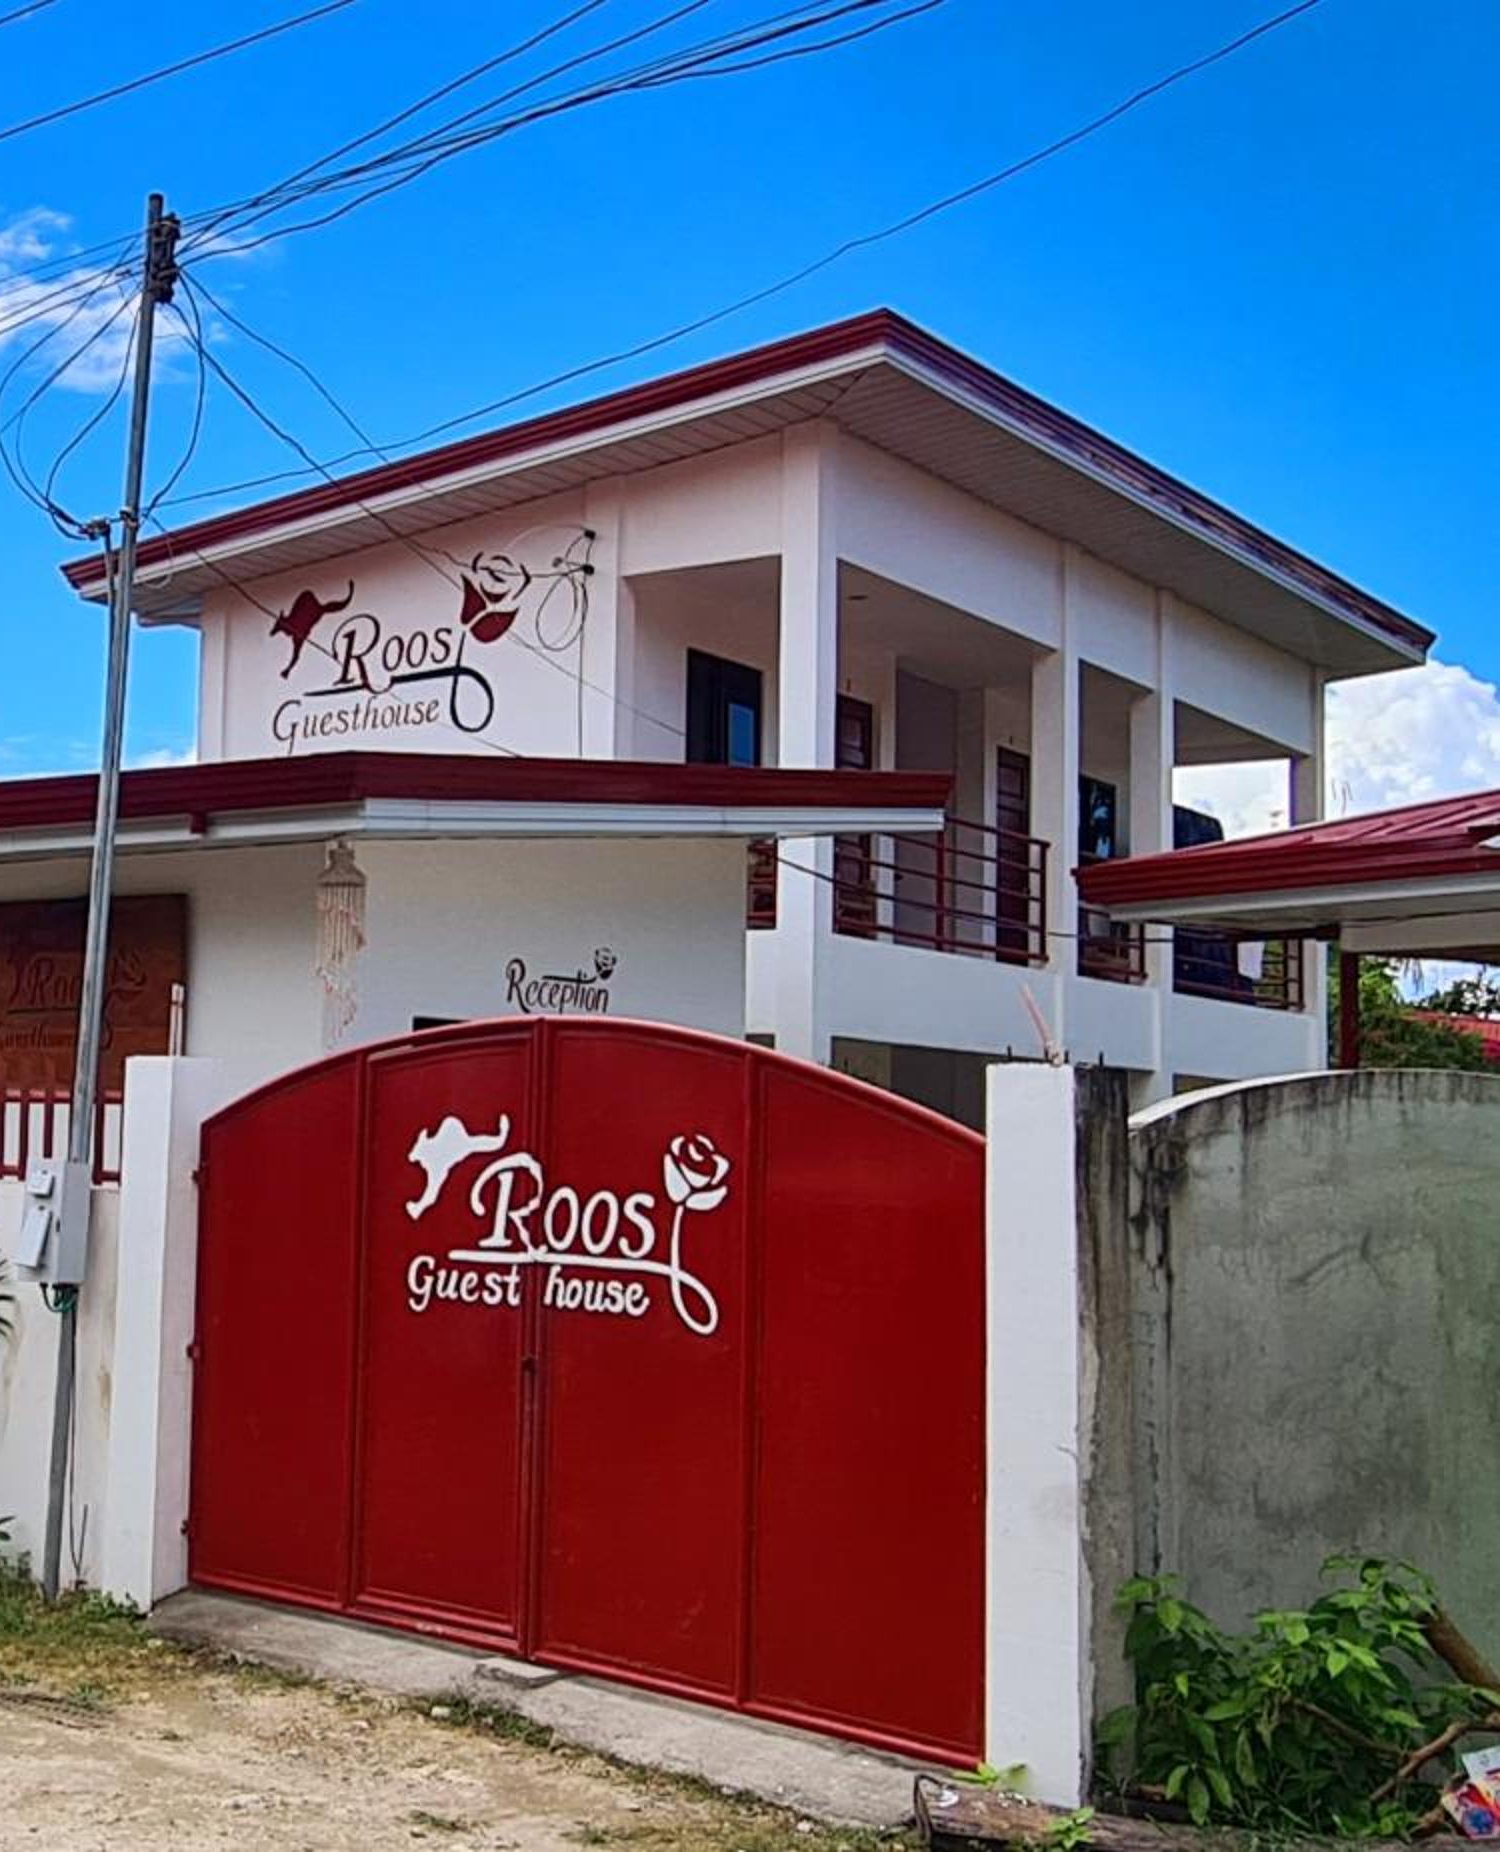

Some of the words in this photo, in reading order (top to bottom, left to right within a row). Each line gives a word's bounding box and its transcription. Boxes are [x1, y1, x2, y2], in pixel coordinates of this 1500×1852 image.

[332, 613, 452, 694] Roos
[273, 698, 440, 754] Guesthouse
[506, 958, 609, 1014] Reception
[471, 1153, 655, 1258] Roos
[407, 1256, 521, 1312] Guest
[544, 1265, 650, 1315] house
